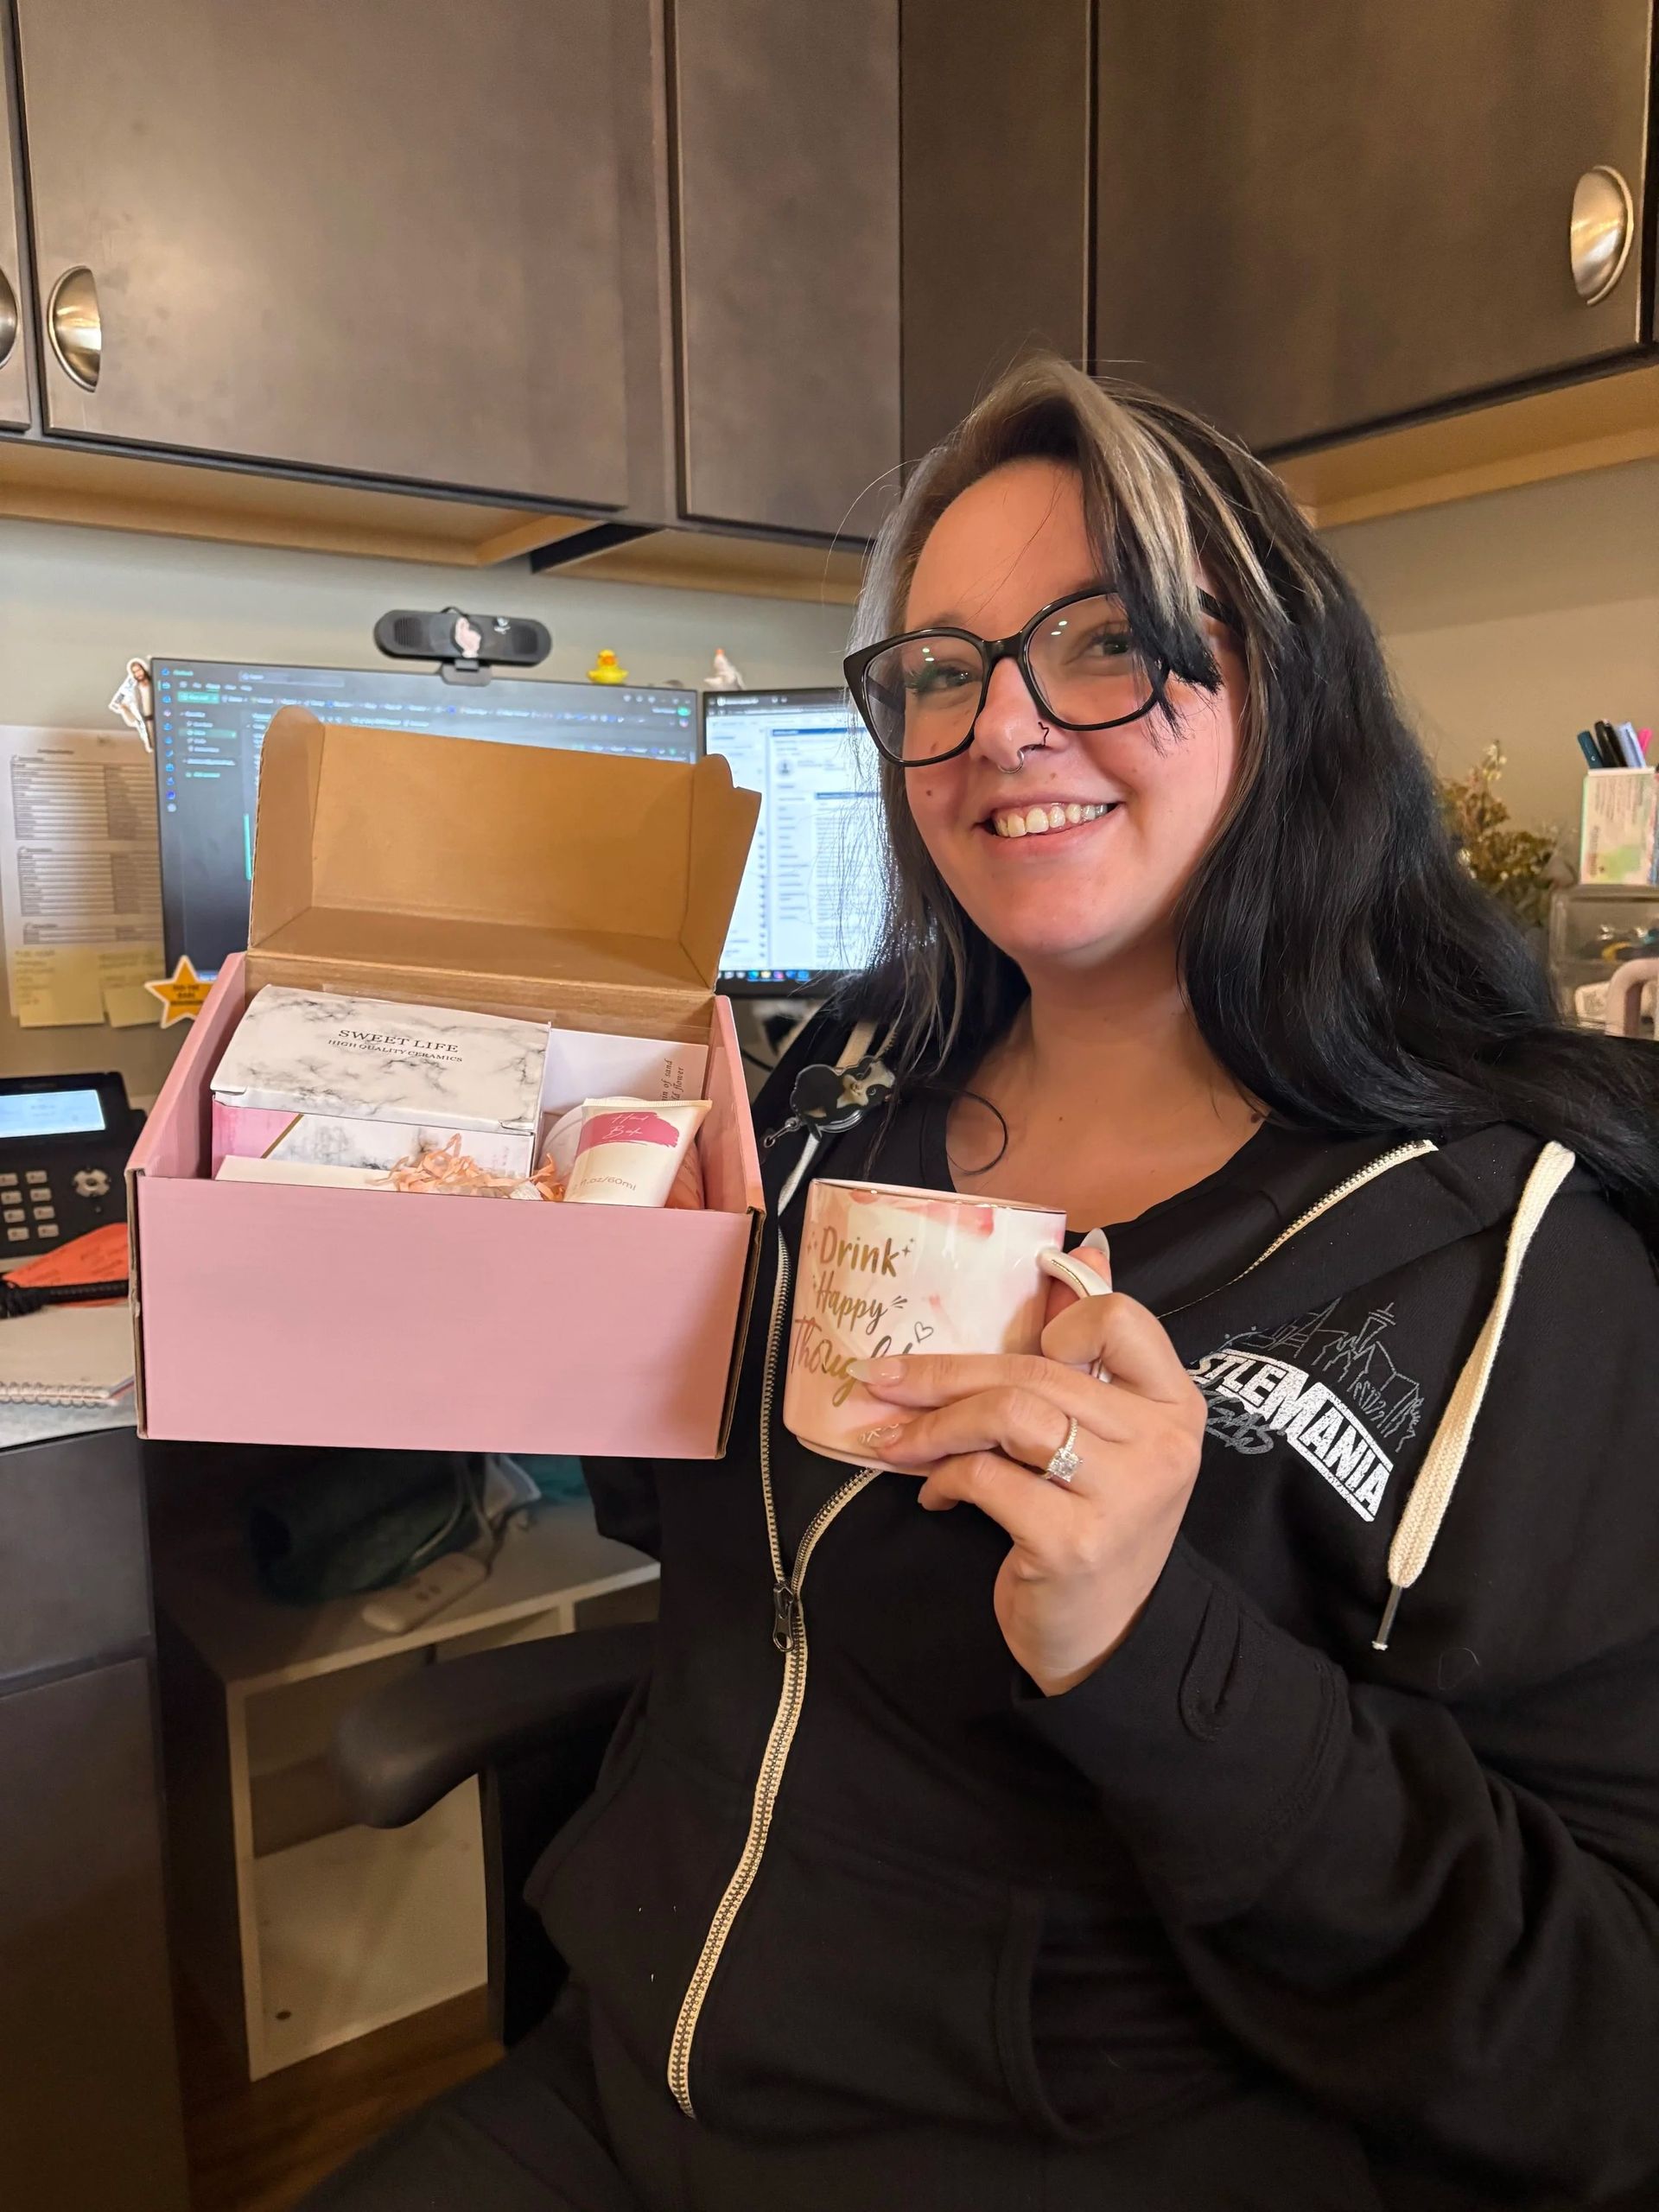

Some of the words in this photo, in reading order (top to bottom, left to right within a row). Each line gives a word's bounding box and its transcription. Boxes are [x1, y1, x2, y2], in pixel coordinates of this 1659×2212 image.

[328, 1039, 357, 1048] HIGH
[359, 1044, 407, 1055] QUALITY
[408, 1050, 462, 1062] CERAMICS
[338, 1030, 410, 1046] SWEET
[414, 1039, 459, 1053] LIFE
[664, 1058, 672, 1077] sand
[661, 1078, 672, 1088] of
[672, 1067, 684, 1093] flower
[820, 1225, 899, 1277] Drink
[815, 1270, 889, 1336] Happy
[790, 1314, 913, 1408] Thoug
